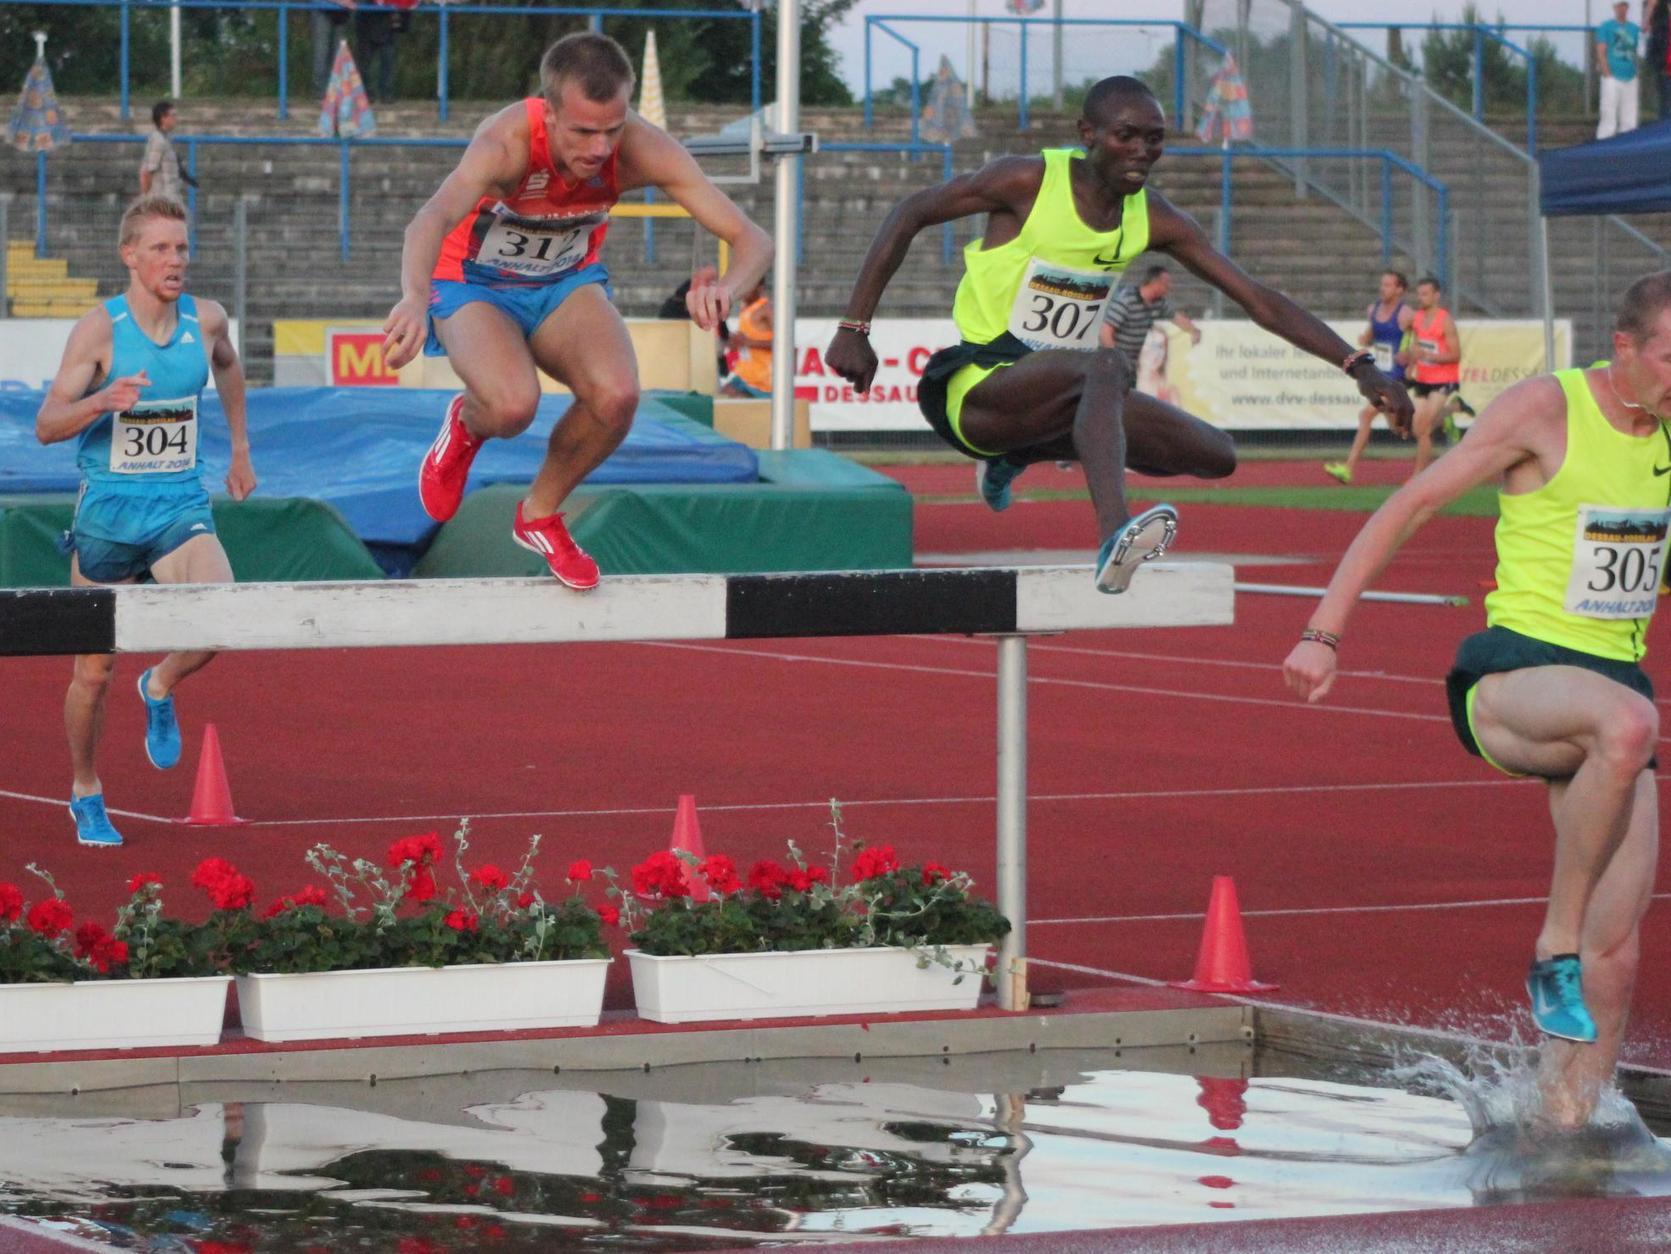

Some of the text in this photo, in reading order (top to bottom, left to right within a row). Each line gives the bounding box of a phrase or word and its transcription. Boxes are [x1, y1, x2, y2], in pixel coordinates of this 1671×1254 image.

[498, 229, 581, 262] 312
[1022, 295, 1100, 340] 307
[1239, 344, 1286, 359] lokaler
[1219, 365, 1247, 380] und
[124, 425, 188, 457] 304
[1587, 547, 1660, 593] 305
